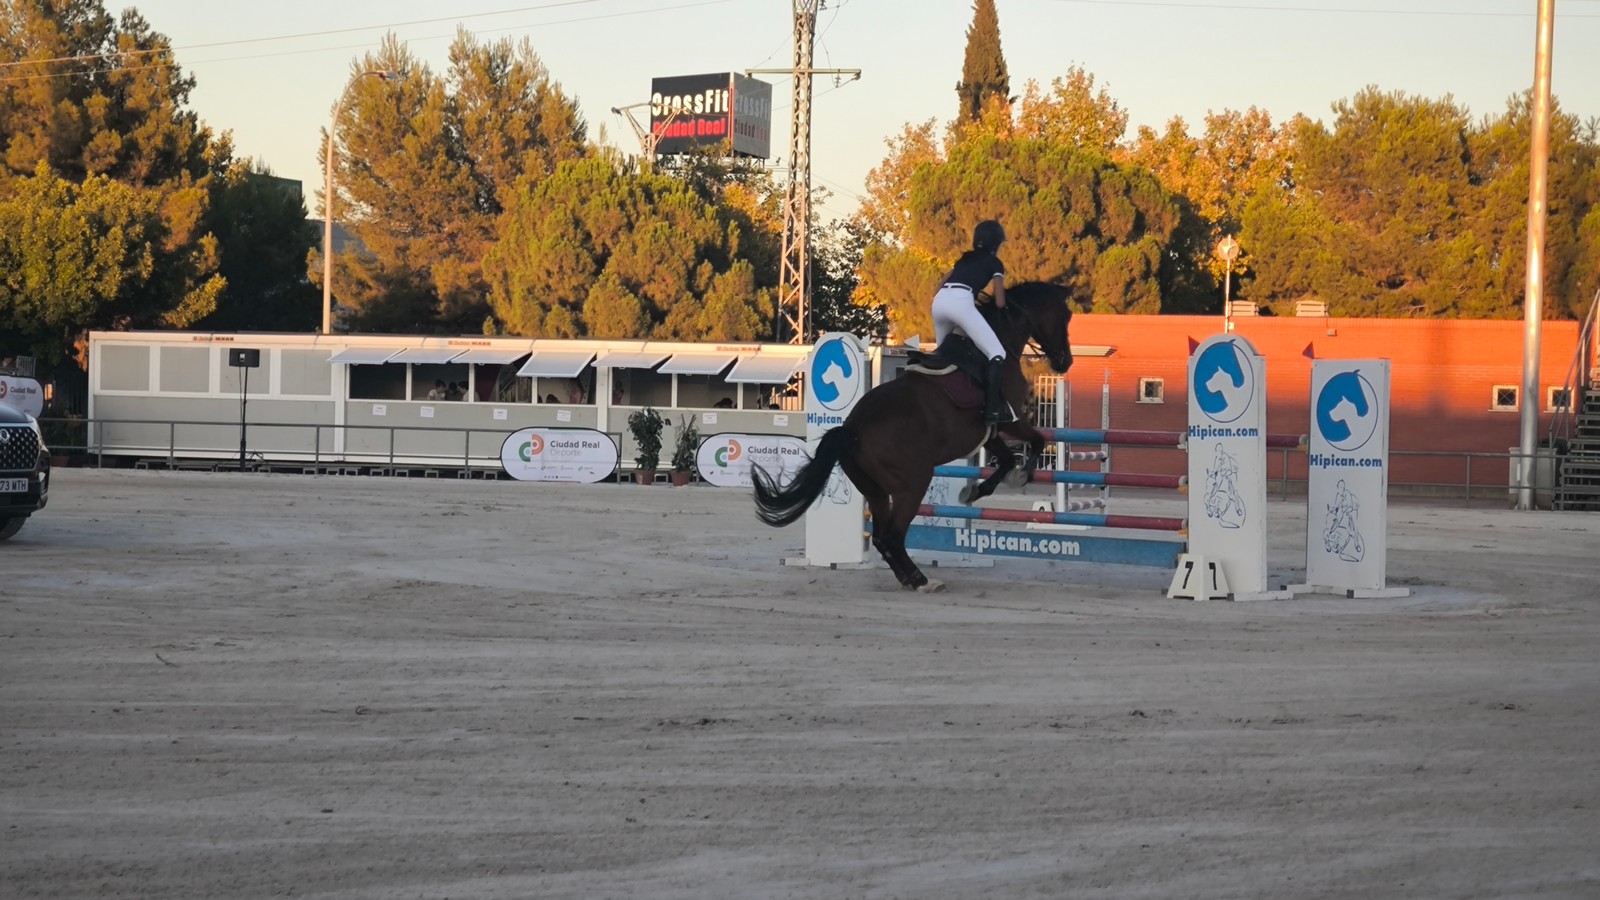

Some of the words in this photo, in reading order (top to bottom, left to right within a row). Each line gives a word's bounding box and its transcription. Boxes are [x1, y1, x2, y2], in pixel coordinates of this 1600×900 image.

[652, 89, 729, 116] CrossFit
[653, 119, 696, 137] Cudad
[697, 117, 726, 136] Real
[1188, 425, 1259, 440] Hipican.com
[550, 440, 580, 449] Ciudad
[582, 440, 600, 449] Real
[550, 448, 581, 456] Deporte
[748, 446, 779, 455] Ciudad
[781, 447, 800, 455] Real
[1310, 454, 1382, 469] Hipican.com
[12, 480, 26, 490] MTH
[955, 528, 1080, 555] Hipican.com
[1182, 561, 1194, 590] 7
